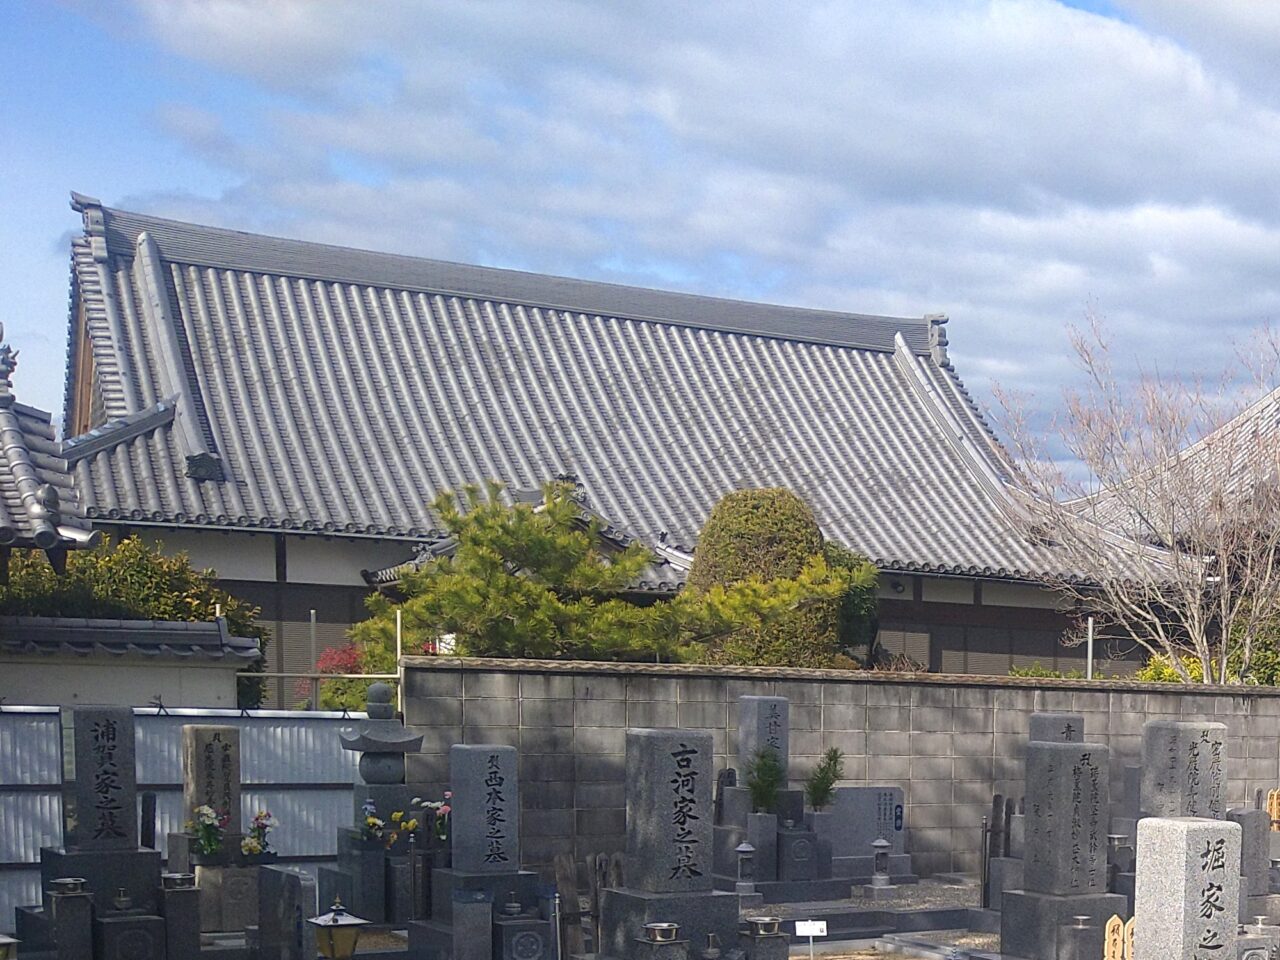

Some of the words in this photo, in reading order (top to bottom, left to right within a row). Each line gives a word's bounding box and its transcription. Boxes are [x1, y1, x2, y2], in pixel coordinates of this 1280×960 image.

[90, 718, 128, 840] 浦賀家之墓
[669, 743, 703, 880] 古河家之墓
